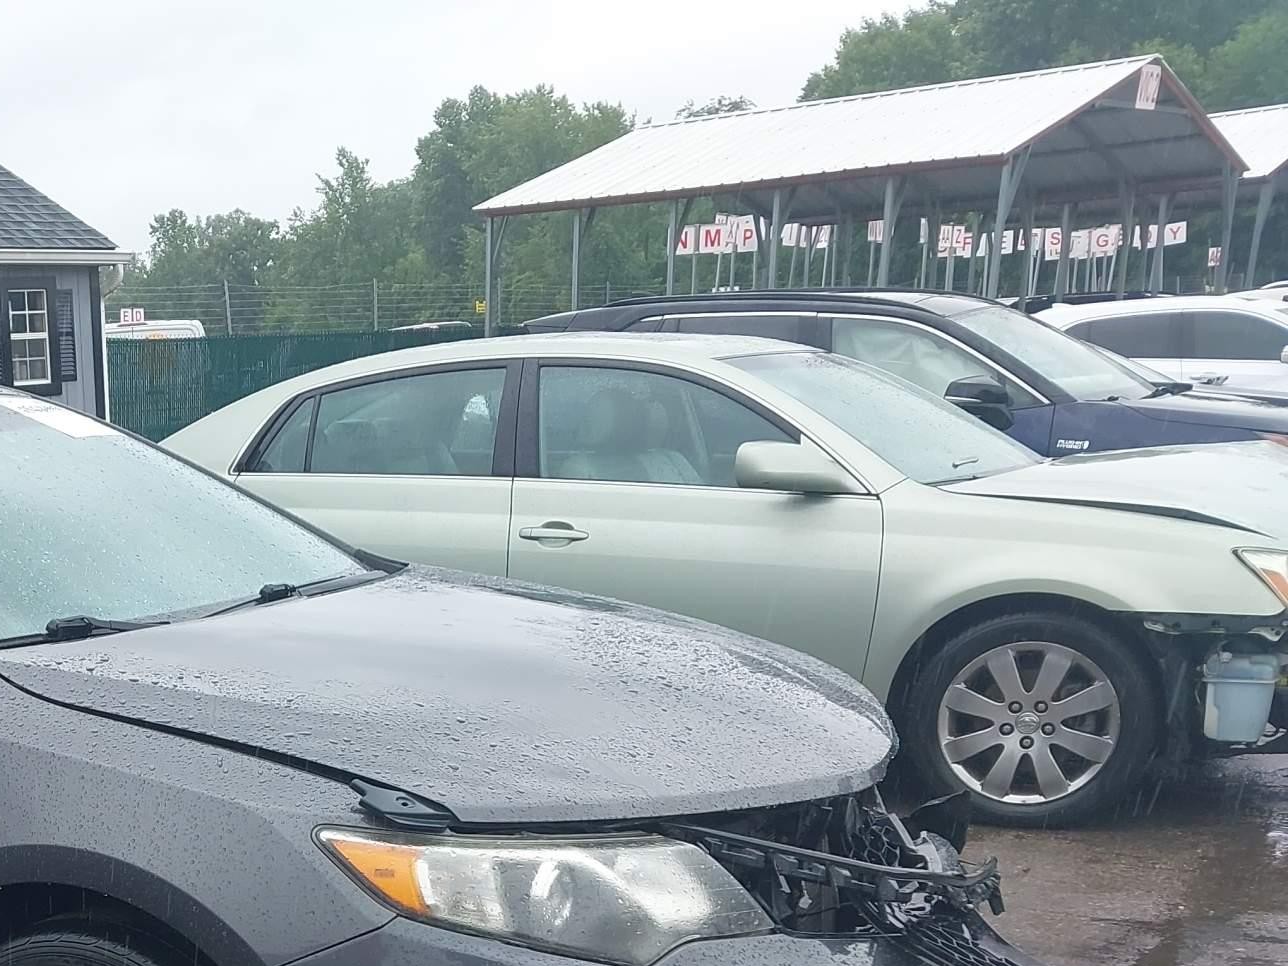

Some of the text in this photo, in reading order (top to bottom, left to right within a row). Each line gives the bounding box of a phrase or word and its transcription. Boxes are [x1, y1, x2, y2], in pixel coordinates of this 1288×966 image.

[705, 228, 721, 248] M
[743, 228, 754, 247] P
[1050, 231, 1061, 246] S
[1096, 233, 1110, 248] G
[1169, 226, 1182, 241] Y
